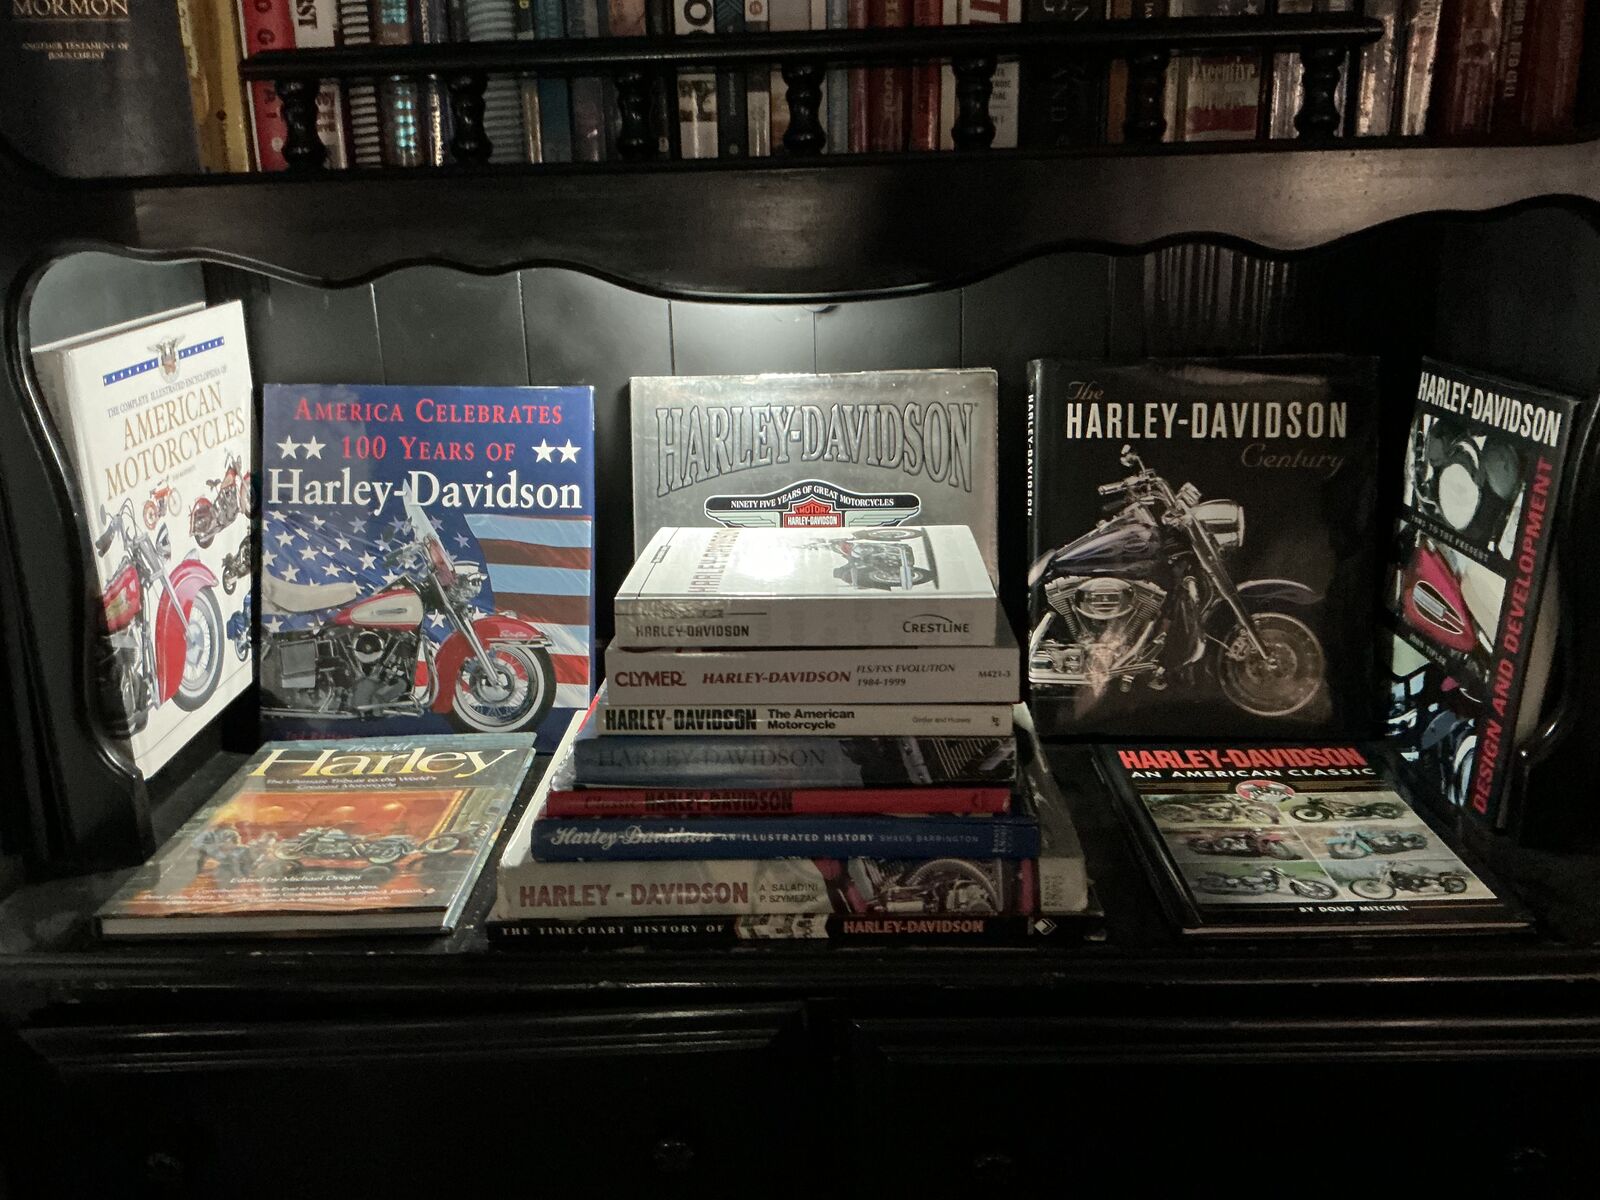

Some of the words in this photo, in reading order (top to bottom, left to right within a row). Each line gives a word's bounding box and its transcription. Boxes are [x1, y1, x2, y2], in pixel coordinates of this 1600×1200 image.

[13, 0, 128, 16] MORMON
[1067, 381, 1104, 400] The
[124, 381, 223, 450] AMERICAN
[294, 397, 404, 423] AMERICA
[416, 398, 563, 425] CELEBRATES
[1066, 402, 1347, 439] HARLEY-DAVIDSON
[1417, 371, 1562, 447] HARLEY-DAVIDSON
[105, 407, 245, 501] MOTORCYCLES
[342, 435, 387, 460] 100
[656, 401, 974, 497] HARLEY-DAVIDSON
[1241, 443, 1344, 478] Century
[267, 467, 583, 516] Harley-Davidson
[731, 499, 759, 508] NINETY
[760, 499, 776, 508] FIVE
[777, 487, 801, 505] YEARS
[802, 485, 813, 495] OF
[813, 486, 839, 499] GREAT
[840, 495, 894, 507] MOTORCYCLES
[787, 516, 838, 526] HARLEY-DAVIDSON
[799, 506, 825, 514] MOTOR
[1503, 456, 1553, 655] DEVELOPMENT
[636, 625, 749, 637] HARLEY-DAVIDSON
[614, 671, 687, 687] CLYMER
[702, 671, 852, 685] HARLEY-DAVIDSON
[895, 664, 956, 673] EVOLUTION
[857, 678, 906, 686] 1984-1999
[1492, 657, 1518, 717] AND
[605, 708, 758, 731] HARLEY-DAVIDSON
[767, 709, 792, 719] The
[795, 709, 855, 719] American
[767, 720, 836, 731] Motorcycle
[247, 746, 517, 779] Harley
[598, 748, 826, 768] HARLEY-DAVIDSON
[1118, 748, 1367, 770] HARLEY-DAVIDSON
[1472, 718, 1503, 815] DESIGN
[1130, 770, 1162, 779] AN
[1172, 768, 1280, 778] AMERICAN
[1288, 767, 1376, 777] CLASSIC
[645, 791, 793, 812] HARLEY-DAVIDSON
[551, 825, 713, 849] Harley-Davidson
[721, 833, 736, 841] AN
[742, 833, 819, 842] ILLUSTRATED
[824, 833, 874, 842] HISTORY
[772, 883, 818, 891] SALADINI
[502, 927, 530, 936] THE
[539, 925, 624, 935] TIMECHART
[634, 924, 697, 934] HISTORY
[706, 924, 725, 933] OF
[844, 920, 984, 934] HARLEY-DAVIDSON
